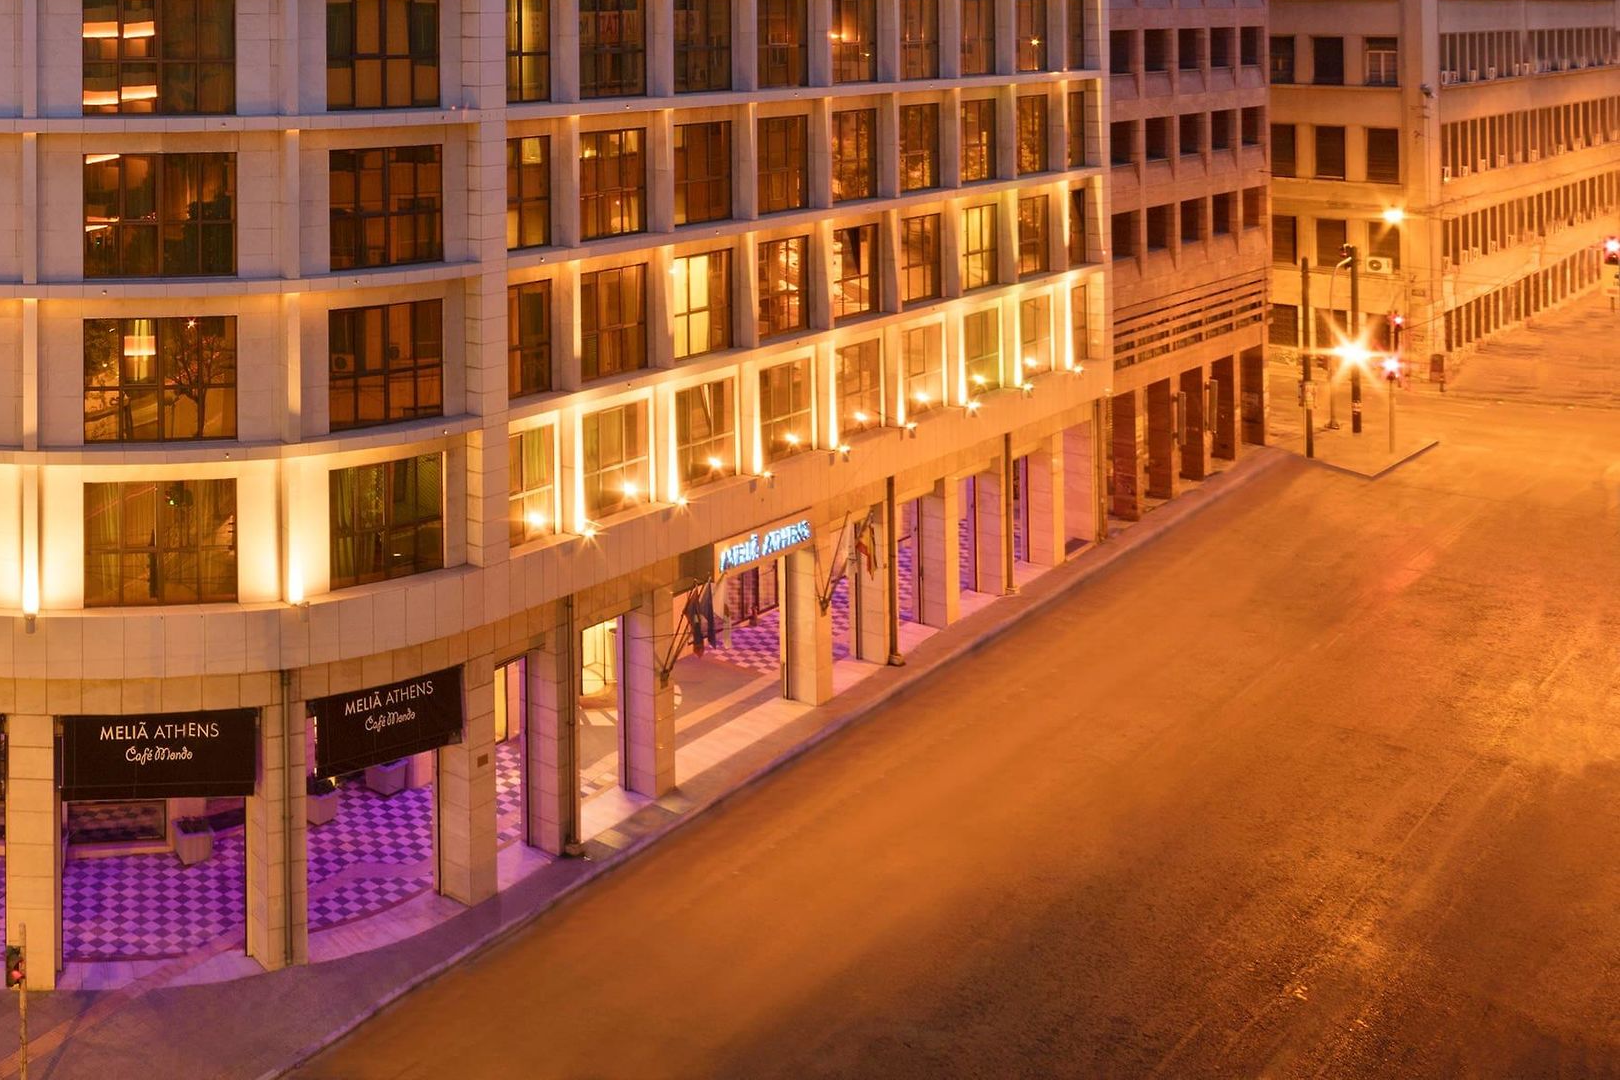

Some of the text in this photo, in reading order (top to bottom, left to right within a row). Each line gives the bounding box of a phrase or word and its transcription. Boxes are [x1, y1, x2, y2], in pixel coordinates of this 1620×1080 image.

[385, 680, 435, 706] ATHENS
[153, 722, 220, 739] ATHENS
[125, 745, 153, 766] Café
